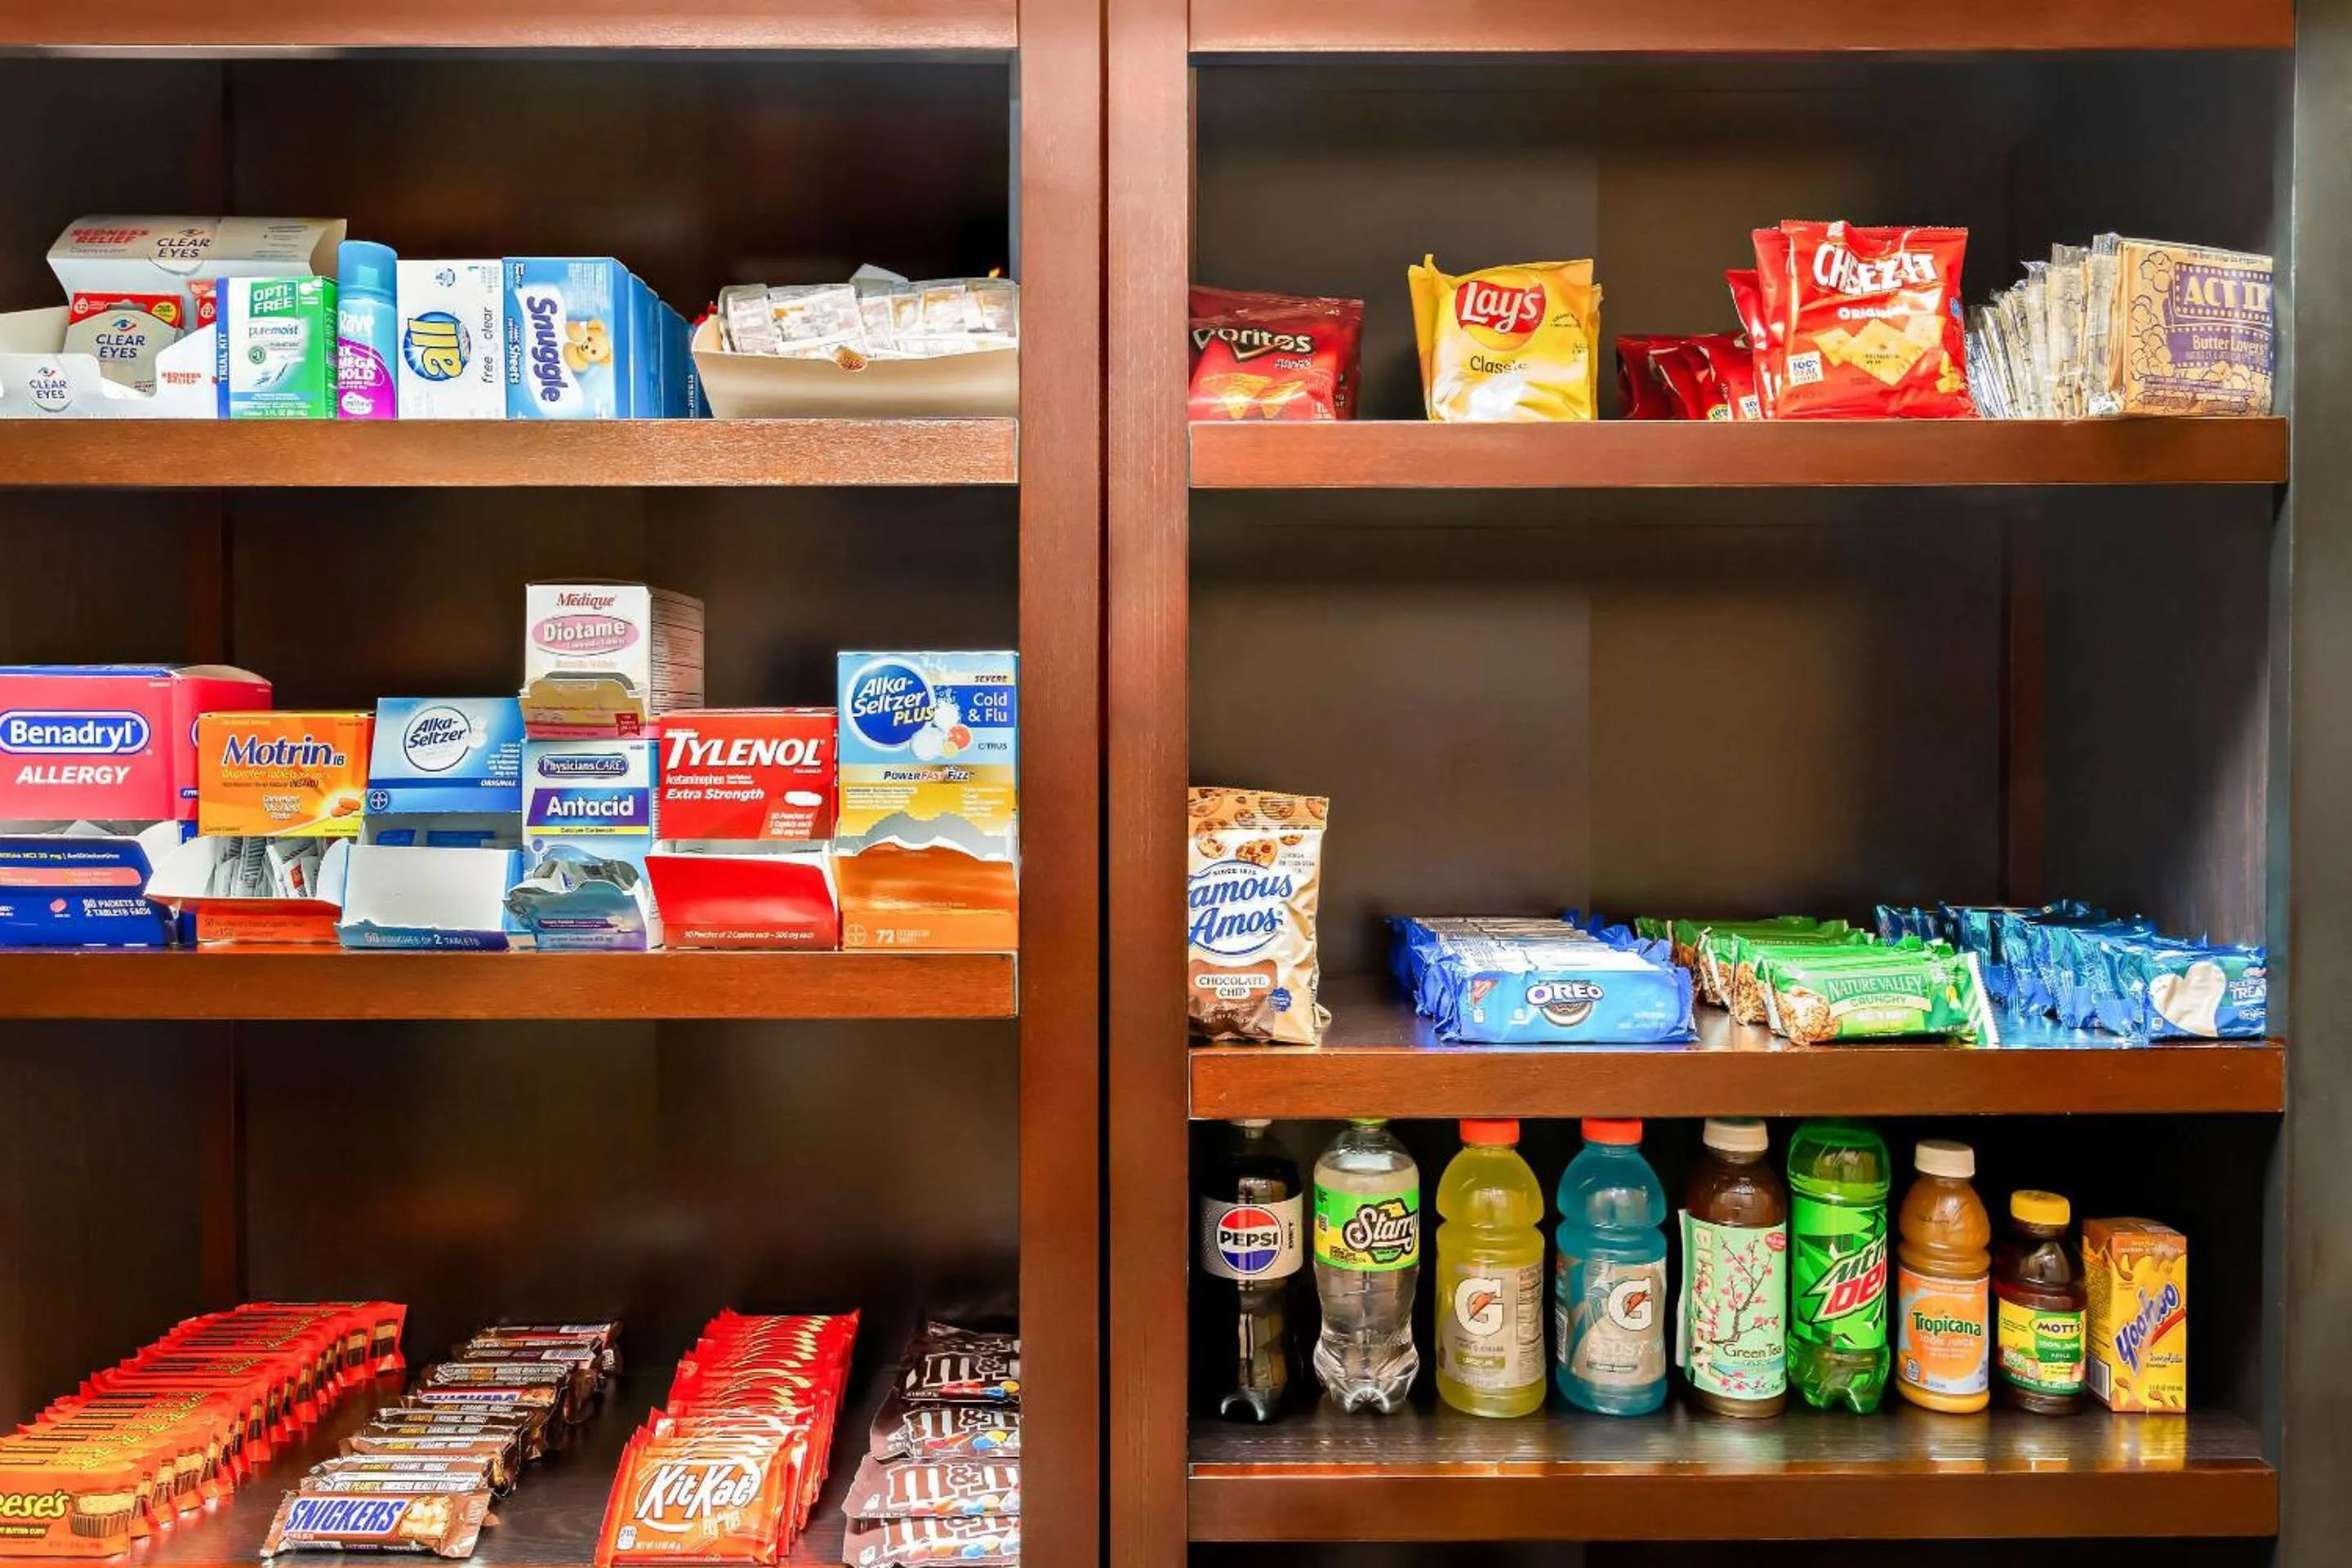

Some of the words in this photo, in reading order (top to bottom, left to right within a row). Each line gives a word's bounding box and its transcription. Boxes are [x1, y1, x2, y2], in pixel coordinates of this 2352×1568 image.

[75, 235, 138, 244] RELIEF
[157, 238, 212, 247] CLEAR
[158, 247, 201, 259] EYES
[253, 285, 293, 301] OPTI-
[2183, 275, 2238, 308] ACT
[2241, 280, 2269, 312] II
[254, 298, 294, 314] FREE
[1460, 280, 1543, 334] Lay's
[249, 324, 298, 338] puremoist
[340, 310, 375, 335] Rave
[481, 307, 494, 340] clear
[96, 333, 146, 347] CLEAR
[219, 332, 228, 349] KIT
[408, 317, 463, 379] all
[526, 296, 568, 403] Snuggle
[1192, 327, 1312, 353] Doritos
[2193, 334, 2230, 351] Butter
[2230, 336, 2265, 356] Lovers
[99, 346, 138, 359] EYES
[509, 342, 520, 385] Sheets
[219, 352, 228, 382] TRIAL
[481, 356, 494, 384] free
[29, 379, 68, 390] CLEAR
[36, 389, 65, 399] EYES
[543, 621, 626, 643] Diotame
[858, 676, 914, 698] Alka-
[852, 689, 927, 718] Seltzer
[973, 692, 1008, 707] Cold
[413, 717, 458, 734] Alka-
[893, 706, 936, 727] PLUS
[968, 708, 981, 722] &
[984, 708, 1008, 723] Flu
[10, 719, 133, 751] Benadryl
[408, 728, 467, 749] Seltzer
[222, 735, 333, 766] Motrin
[333, 754, 345, 766] IB
[664, 731, 823, 769] TYLENOL
[16, 765, 131, 784] ALLERGY
[666, 788, 702, 800] Extra
[705, 788, 764, 801] Strength
[546, 795, 635, 817] Antacid
[1188, 874, 1294, 909] amous
[875, 929, 896, 944] 72
[1188, 906, 1284, 945] Amos
[434, 933, 443, 945] 2
[1198, 976, 1267, 987] CHOCOLATE
[1218, 987, 1247, 998] CHIP
[1829, 978, 1878, 1000] NATURE
[1878, 974, 1925, 993] VALLEY
[1526, 982, 1605, 1005] OREO
[1849, 994, 1908, 1007] CRUNCHY
[1219, 1230, 1279, 1247] PEPSI
[1824, 1258, 1886, 1315] DE
[1454, 1277, 1503, 1337] G
[1607, 1277, 1653, 1332] G
[1913, 1312, 1981, 1337] Tropicana
[1722, 1343, 1766, 1359] Green
[1766, 1343, 1782, 1355] Tea
[633, 1464, 755, 1520] KitKat
[0, 1490, 69, 1517] ese's
[284, 1499, 407, 1533] SNICKERS
